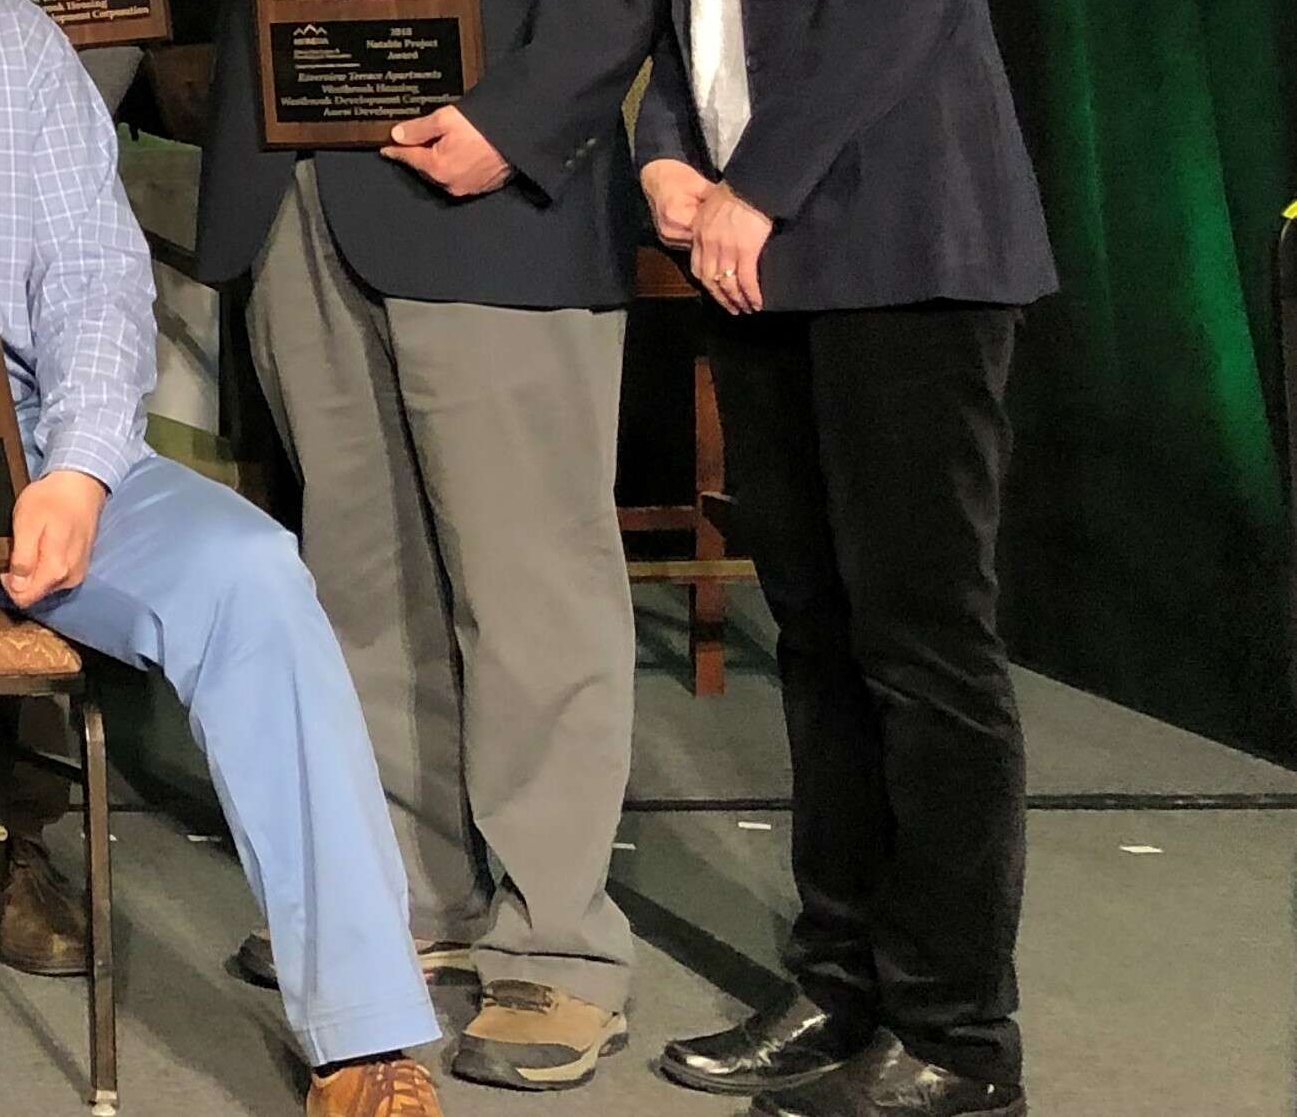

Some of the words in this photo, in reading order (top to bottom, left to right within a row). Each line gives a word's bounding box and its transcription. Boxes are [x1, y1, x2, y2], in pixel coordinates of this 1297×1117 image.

[92, 5, 150, 20] Corporation
[366, 39, 402, 49] Notable
[404, 39, 438, 50] Project
[387, 51, 419, 60] Award
[348, 71, 383, 81] Terrace
[385, 70, 442, 83] Apartments
[321, 84, 374, 94] Westbrook
[280, 97, 332, 106] Westbrook
[334, 95, 401, 107] Development
[353, 106, 421, 118] Development
